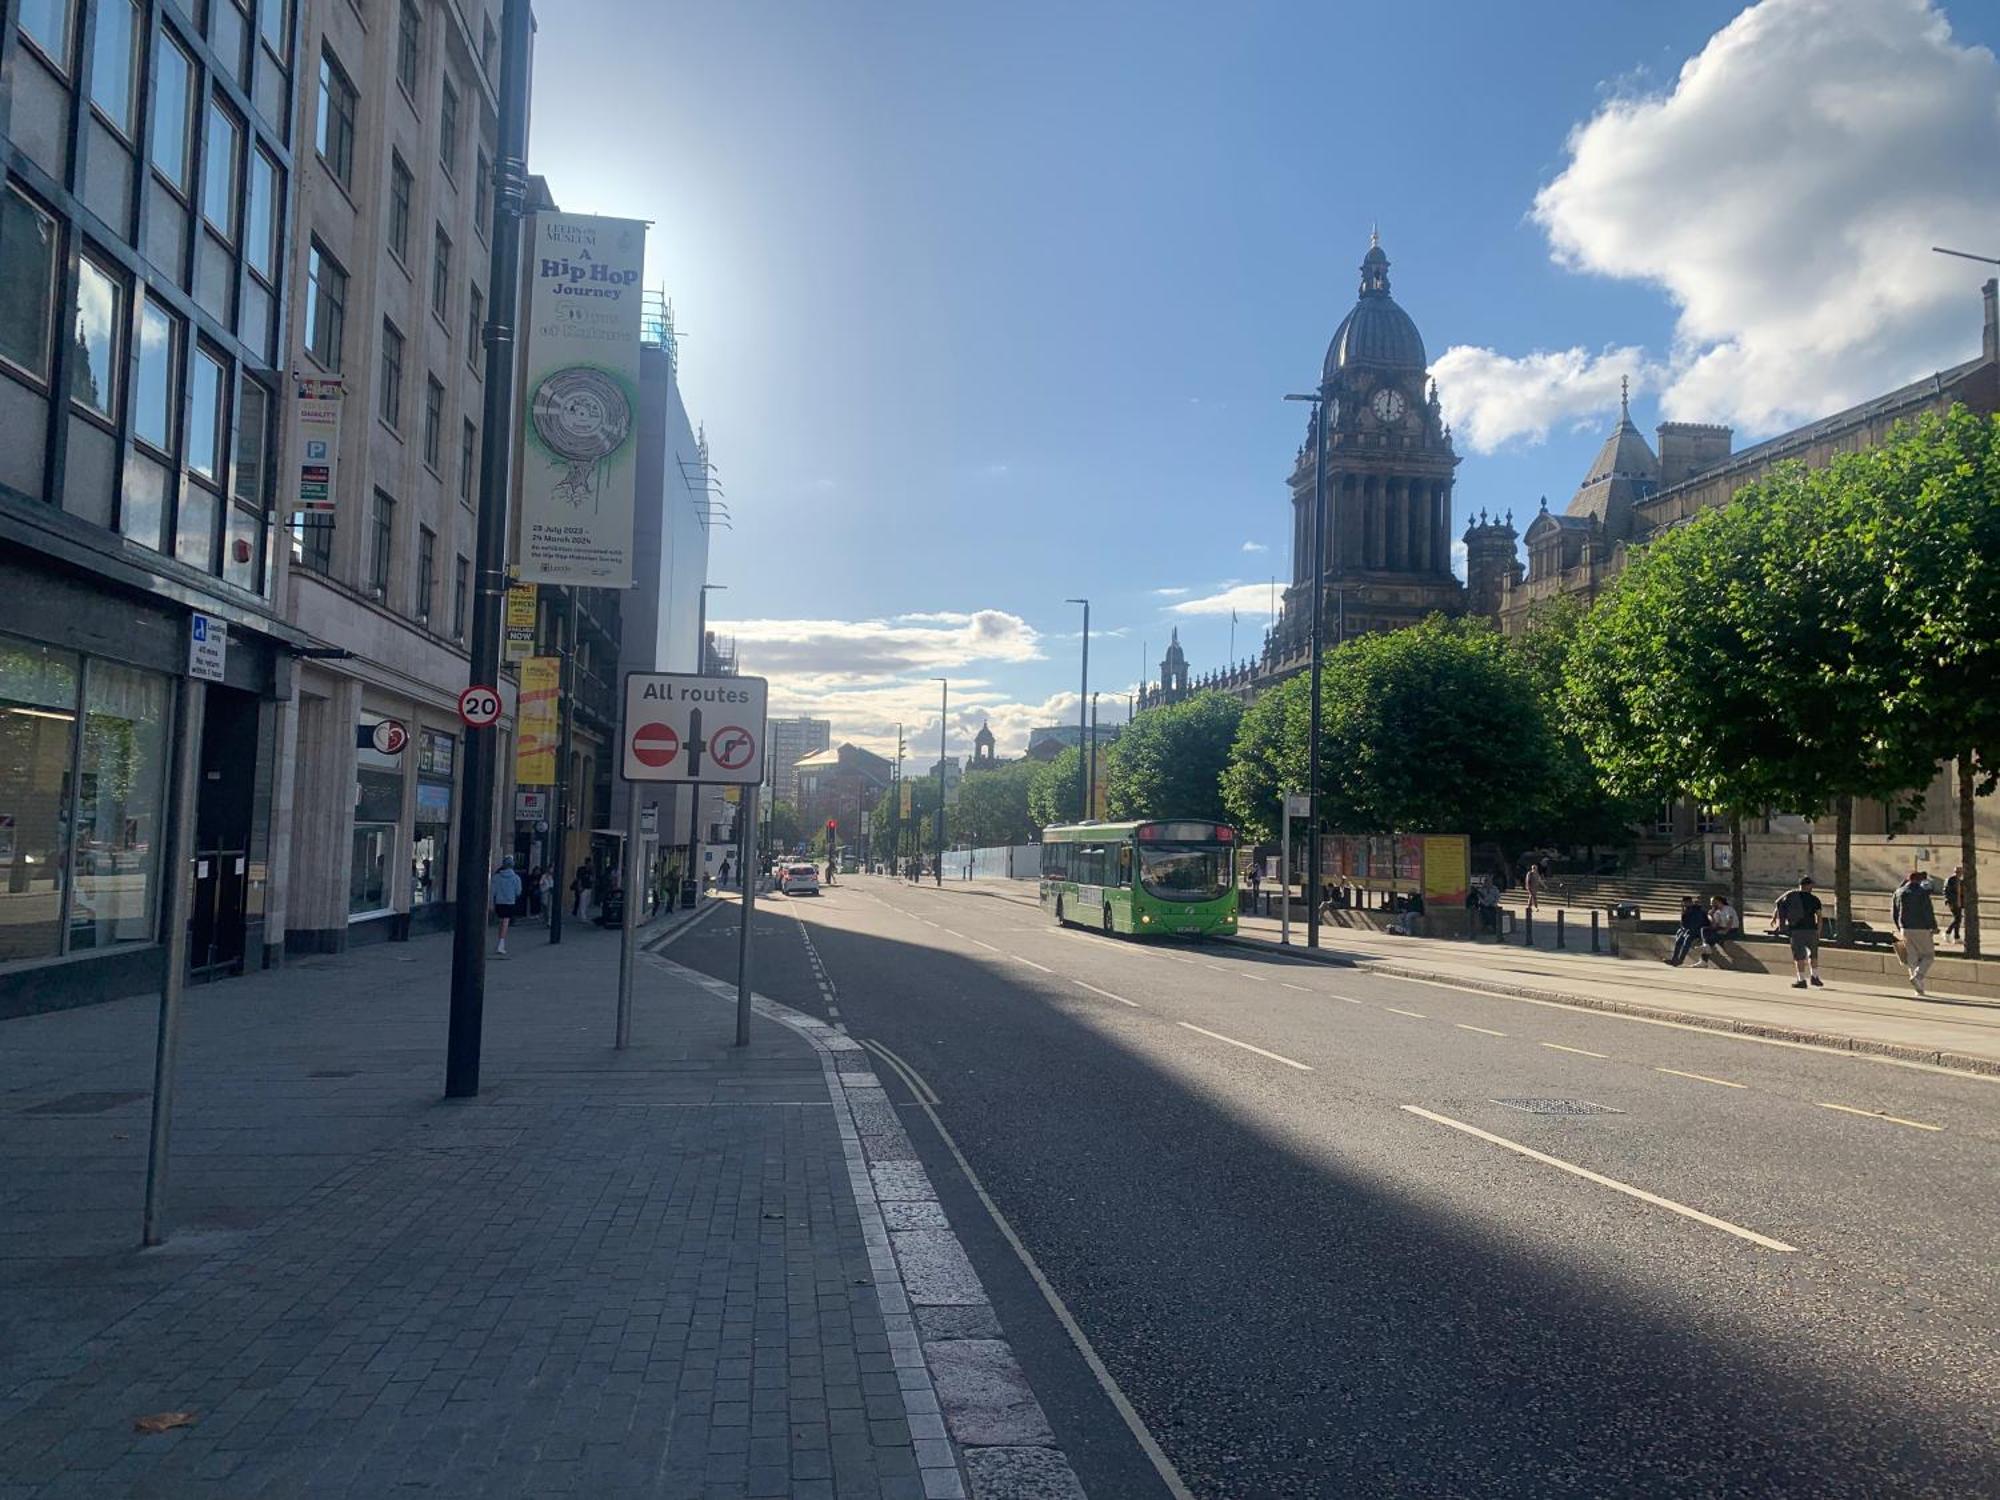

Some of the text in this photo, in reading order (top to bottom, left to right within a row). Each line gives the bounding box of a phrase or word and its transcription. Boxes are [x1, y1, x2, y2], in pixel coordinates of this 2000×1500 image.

[579, 248, 592, 260] A
[541, 258, 638, 286] Hip Hop
[552, 283, 621, 300] Journey
[544, 526, 562, 535] July
[544, 535, 570, 543] March
[571, 537, 591, 545] 2024
[510, 632, 532, 640] NOW
[643, 683, 750, 703] All routes
[465, 698, 496, 715] 20
